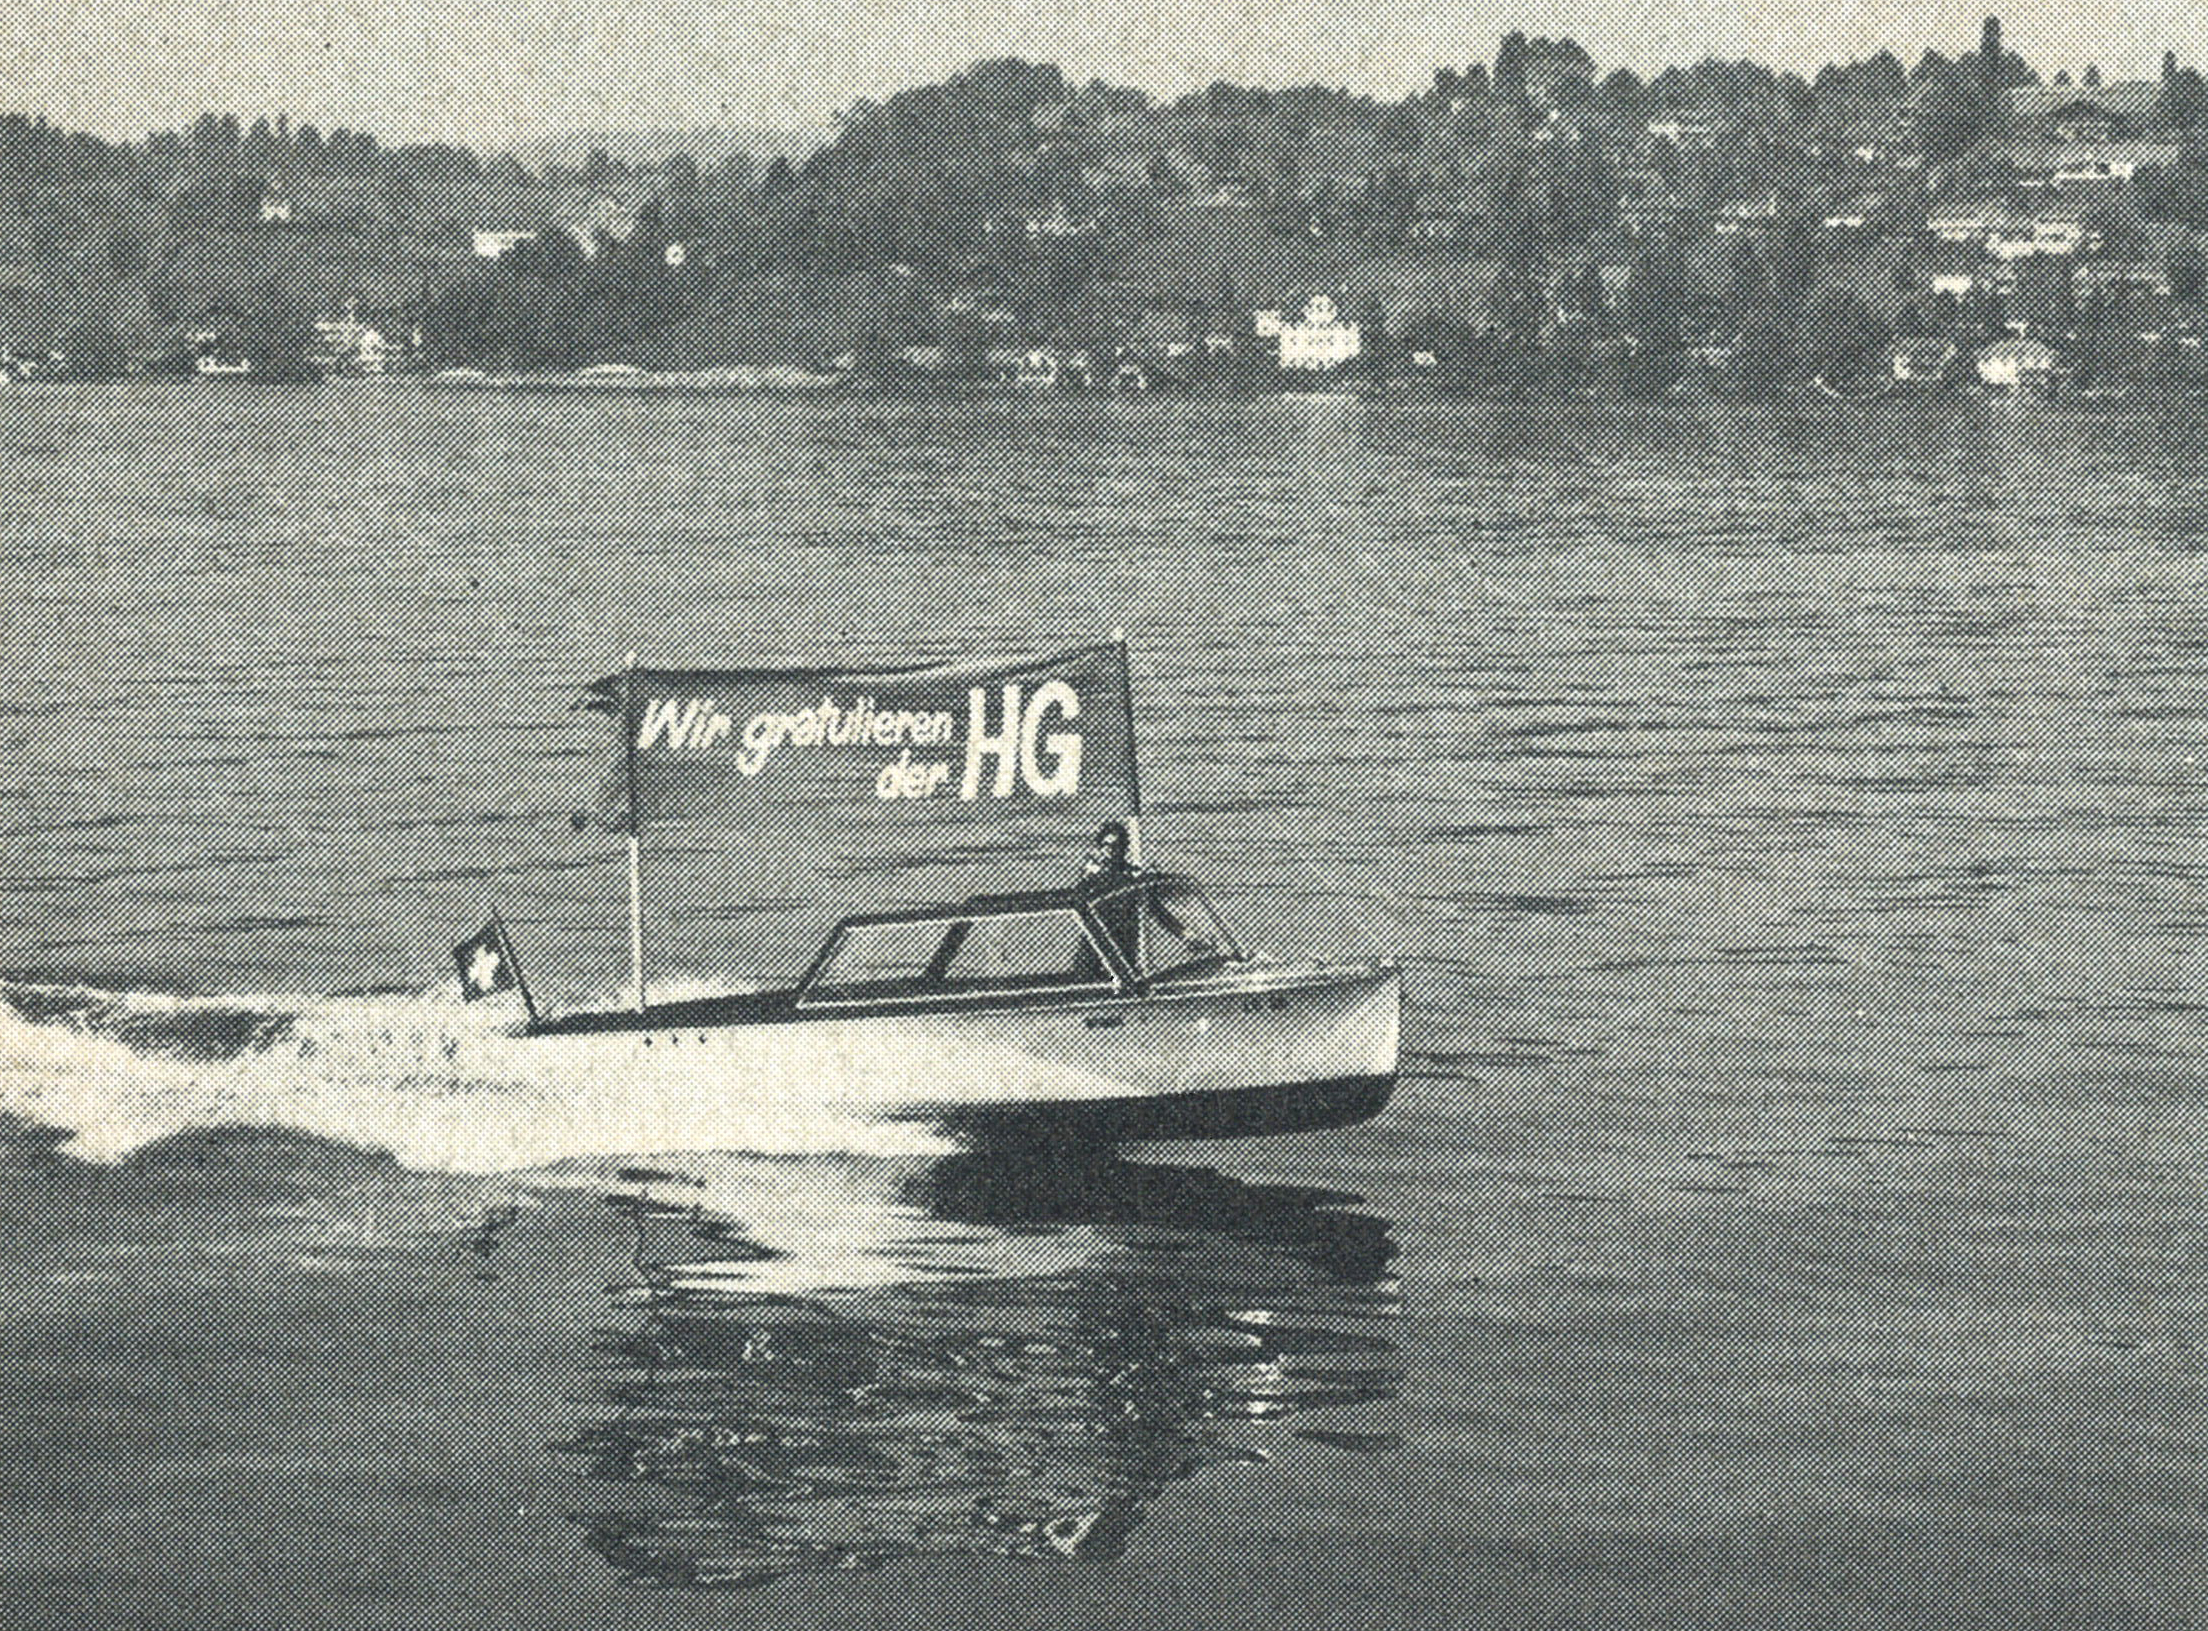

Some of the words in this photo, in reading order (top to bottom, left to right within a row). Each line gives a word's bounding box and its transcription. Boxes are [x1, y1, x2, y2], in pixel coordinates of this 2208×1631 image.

[636, 698, 732, 752] Wir
[736, 696, 954, 776] gratulieren
[875, 751, 951, 800] der
[960, 680, 1084, 800] HG
